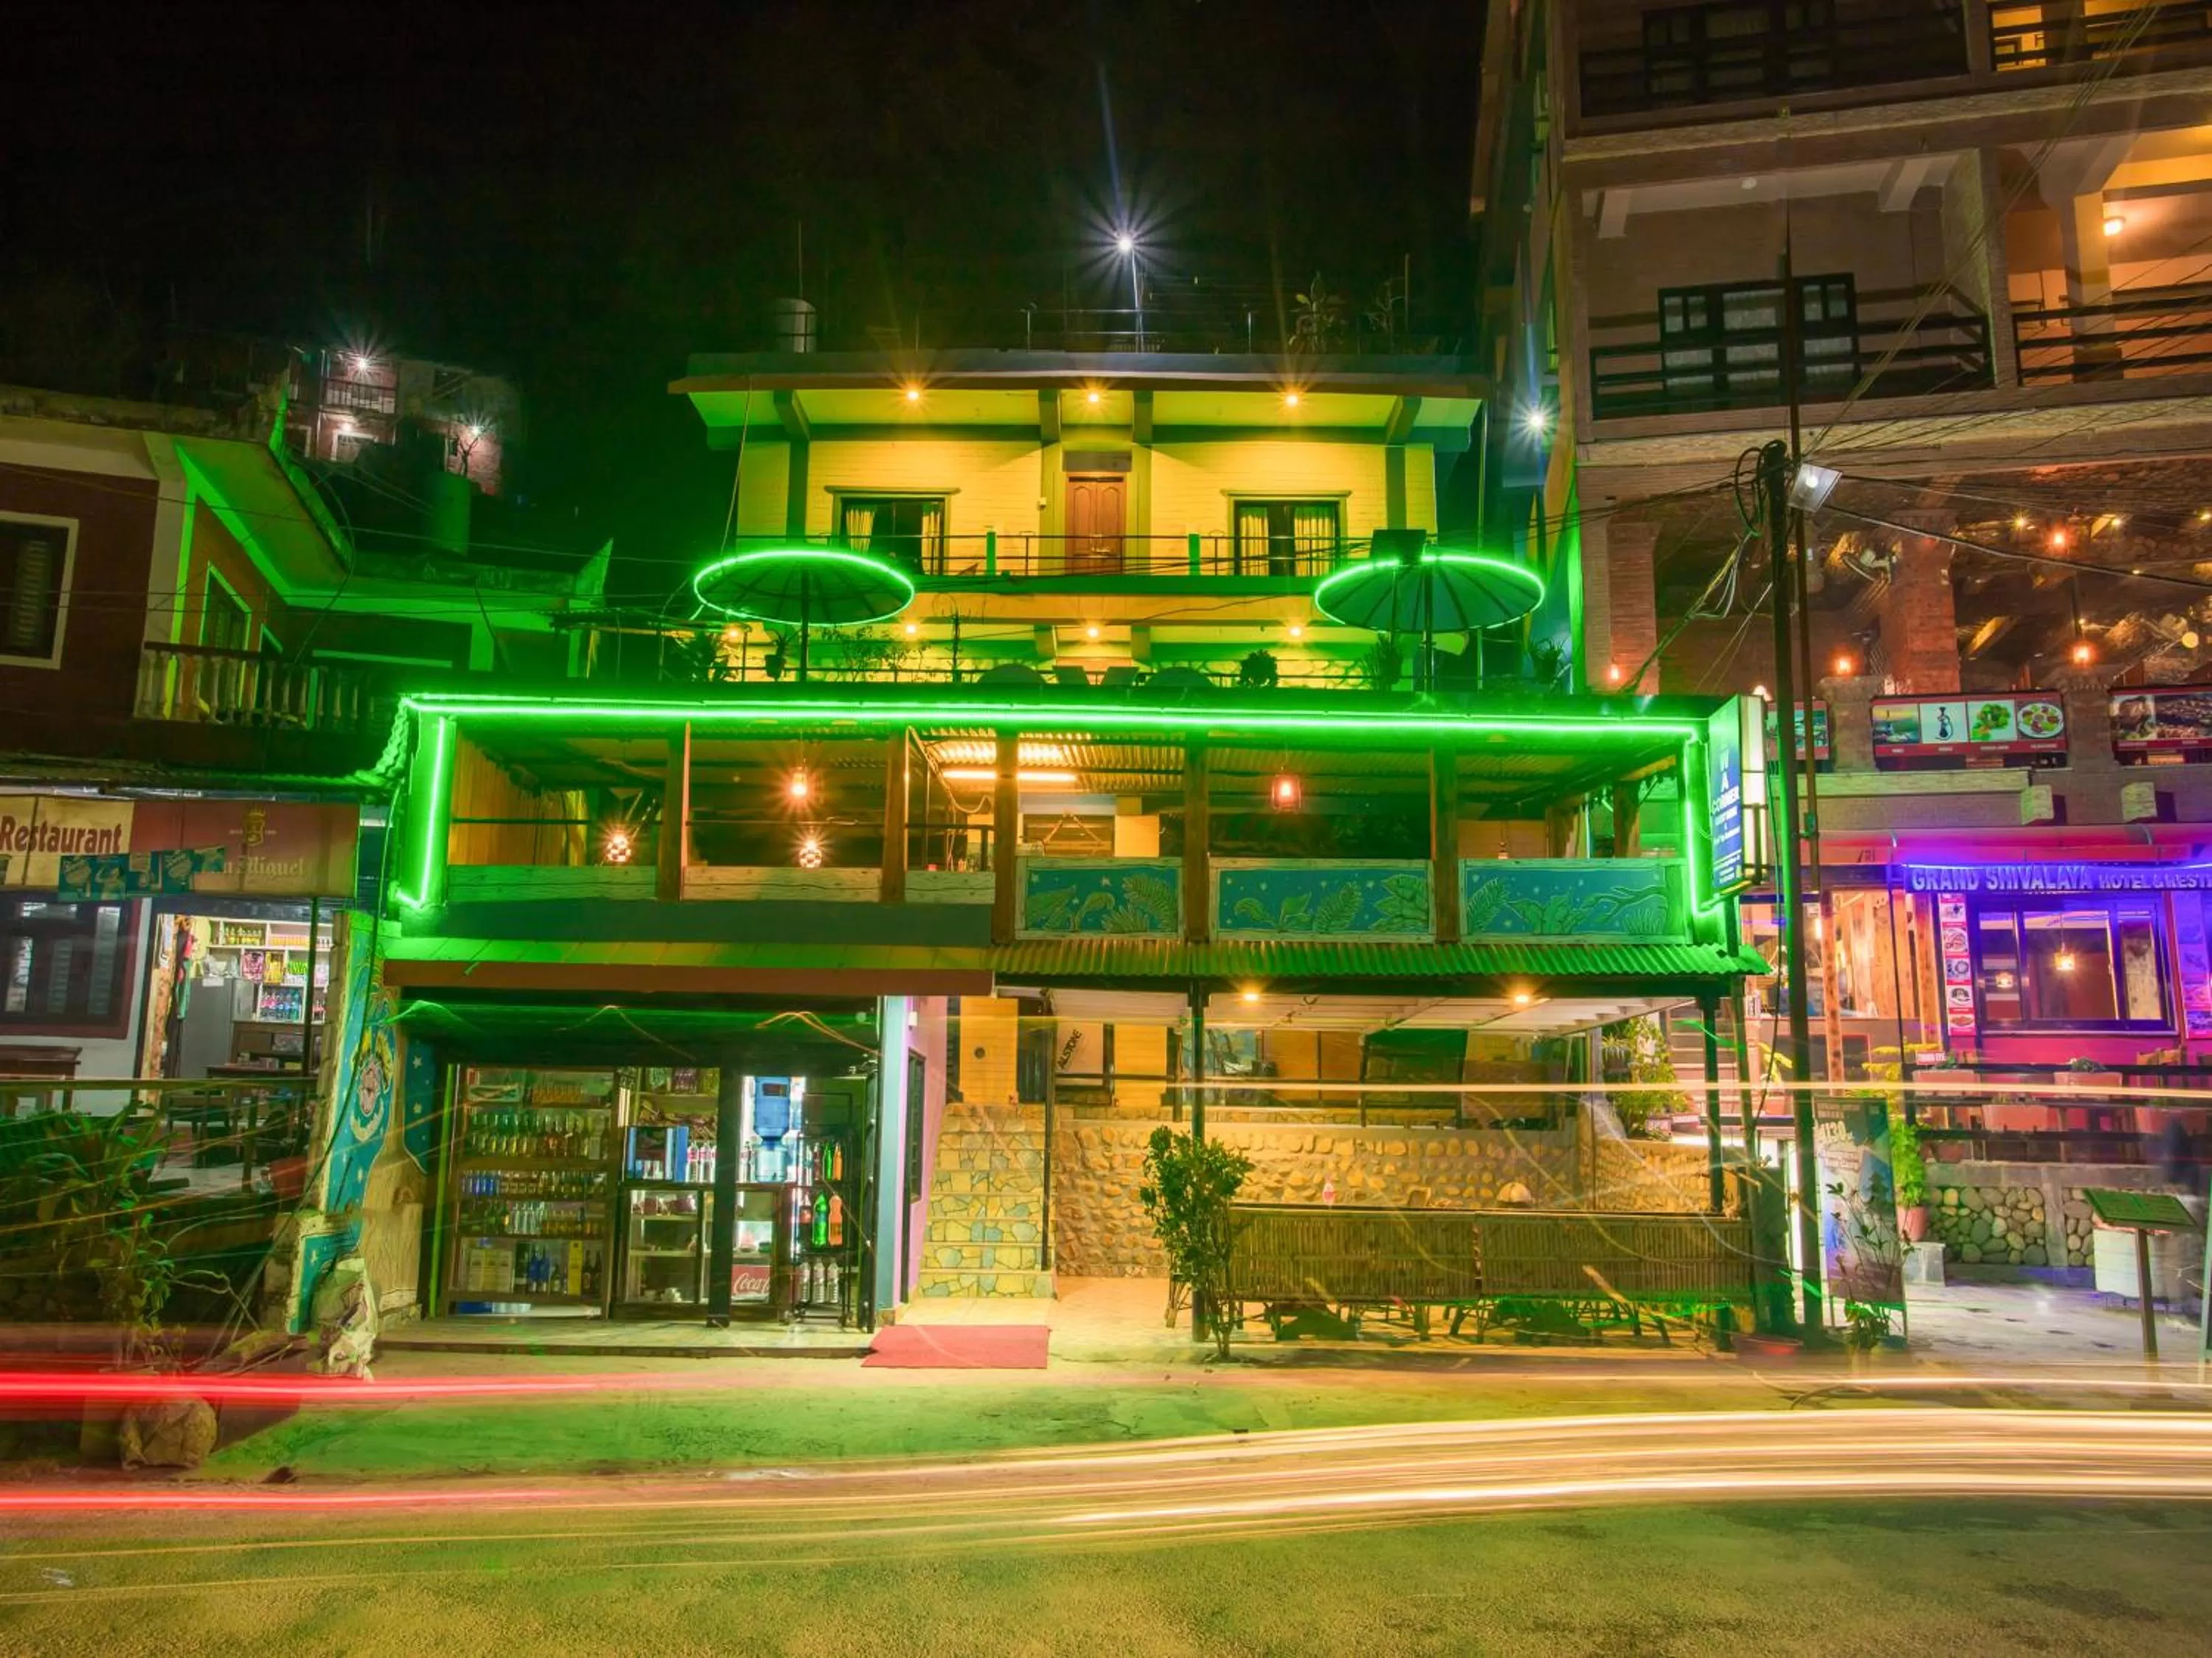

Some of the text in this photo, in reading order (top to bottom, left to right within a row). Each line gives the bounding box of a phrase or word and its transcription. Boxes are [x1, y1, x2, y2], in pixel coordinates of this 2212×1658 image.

[0, 816, 122, 853] Restaurant
[1911, 866, 1980, 891] GRAND
[1986, 864, 2093, 890] SHIVALAYA
[2098, 873, 2152, 889] HOTEL
